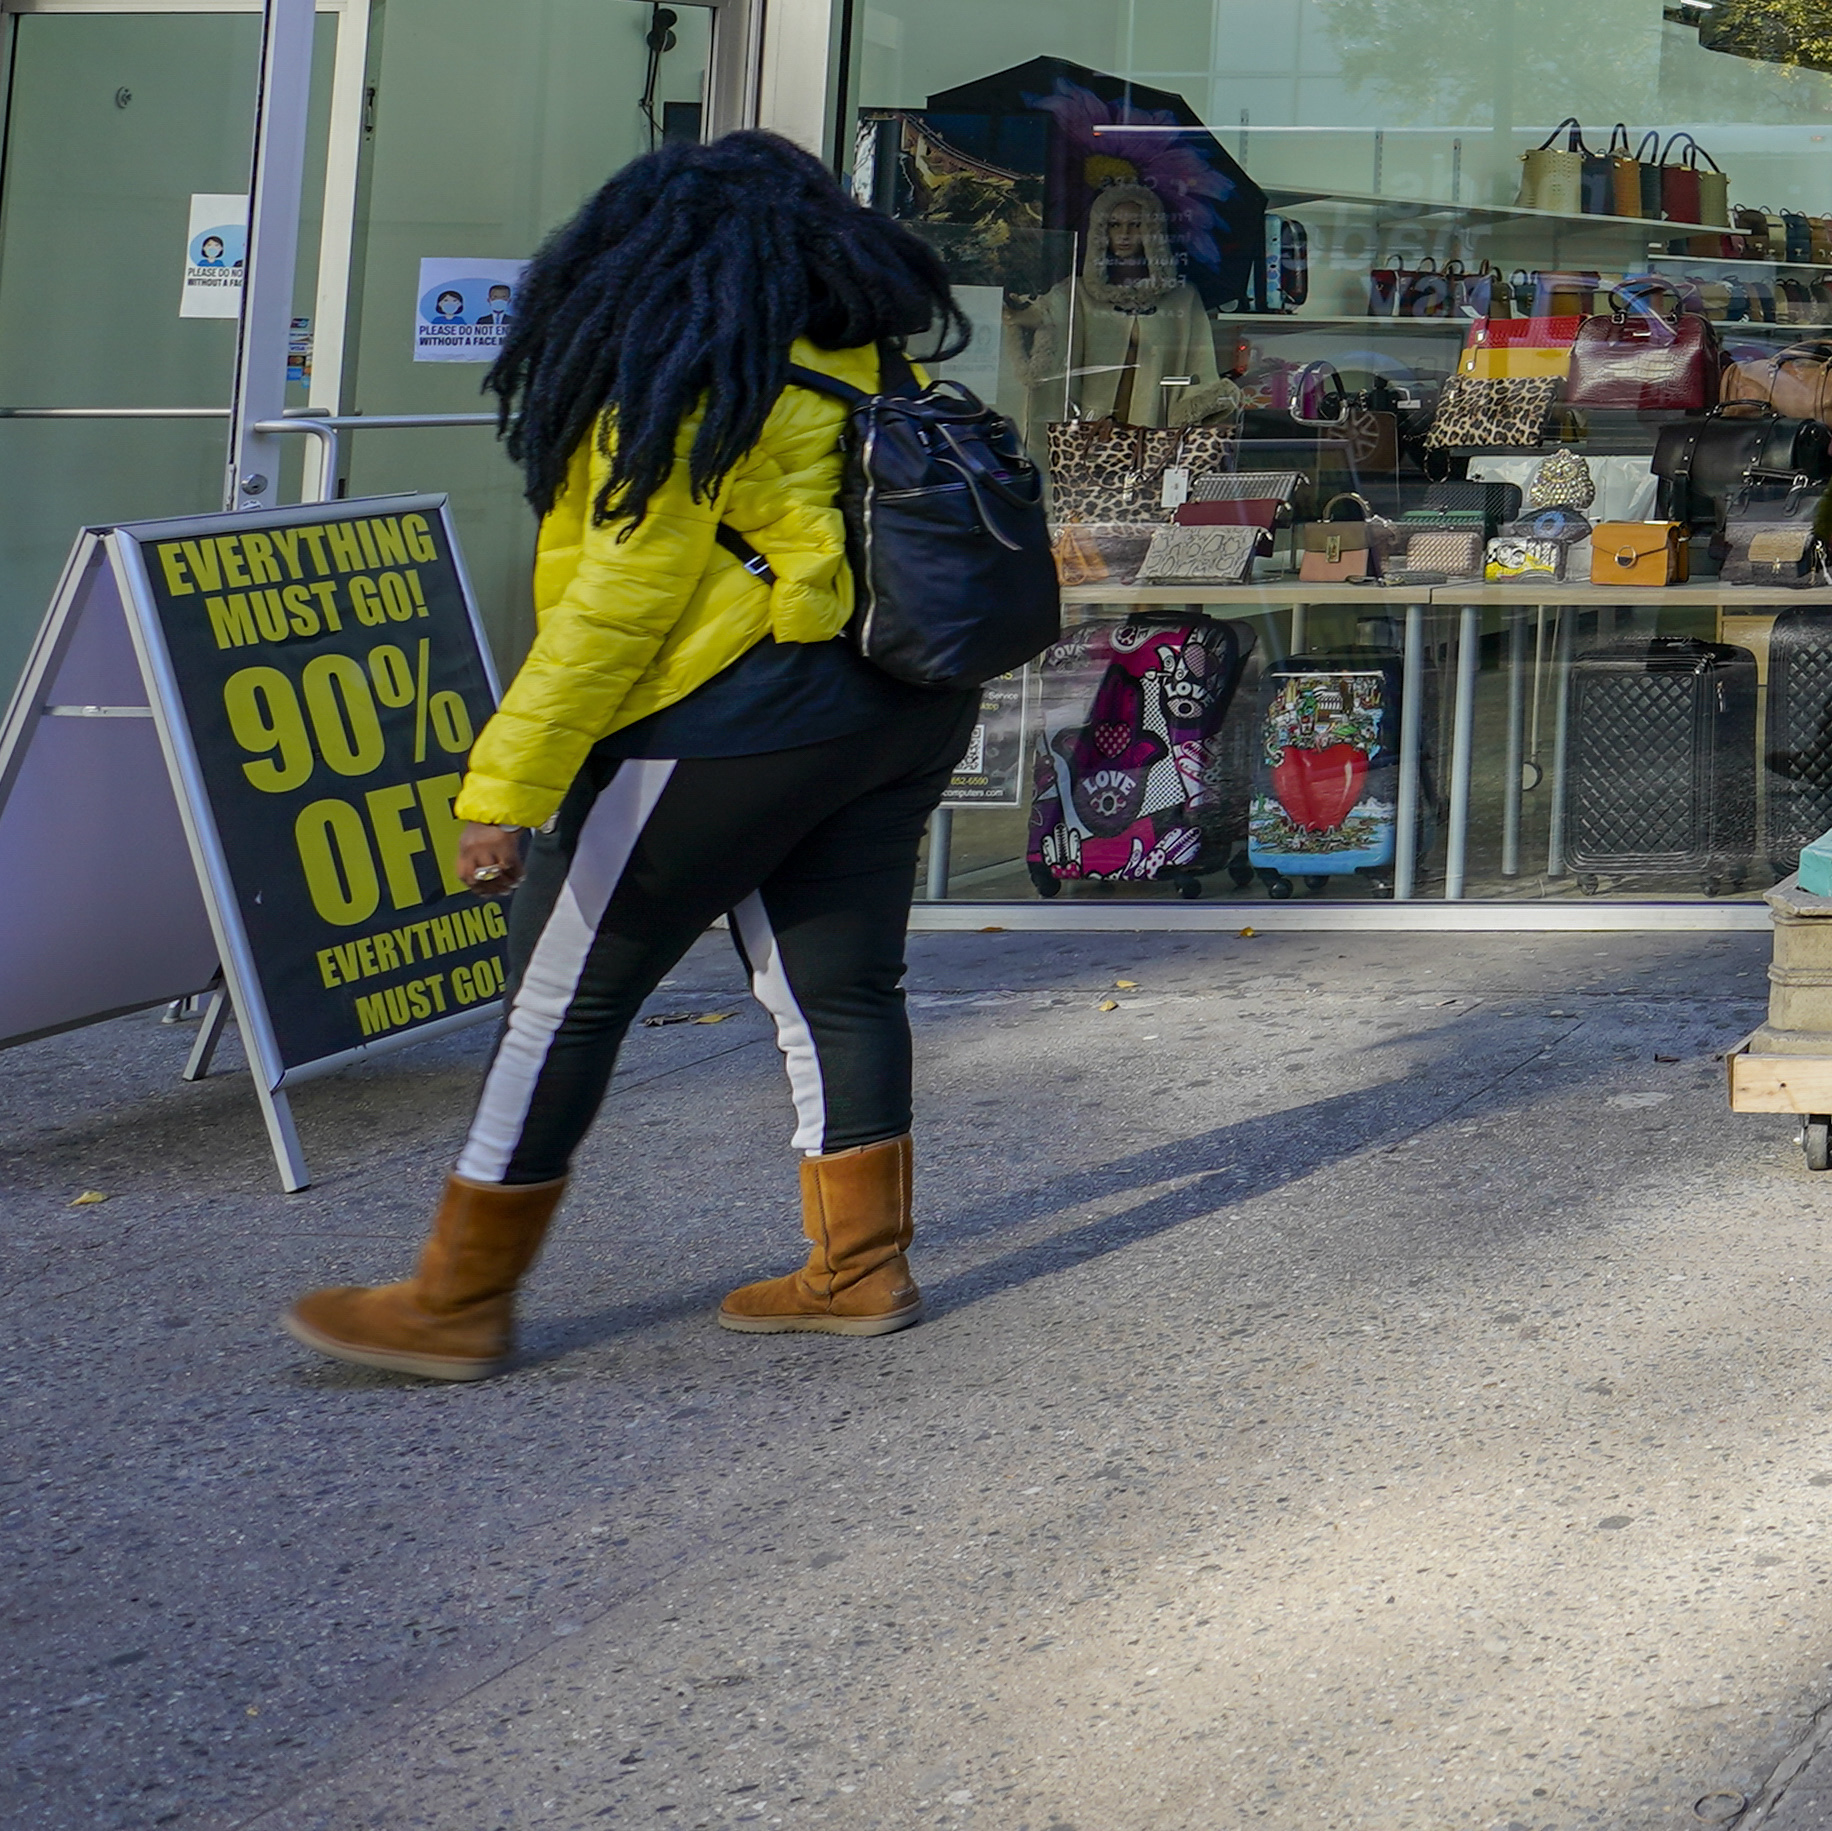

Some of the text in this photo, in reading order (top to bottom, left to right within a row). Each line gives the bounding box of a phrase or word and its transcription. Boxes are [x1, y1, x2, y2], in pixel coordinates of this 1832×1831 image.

[188, 268, 230, 278] PLEASE DO
[188, 278, 222, 287] WITHOUT
[419, 336, 495, 346] WITHOUT A FACE
[420, 325, 456, 336] PLEASE
[458, 325, 473, 336] DO
[474, 325, 493, 336] NOT
[157, 513, 436, 597] EVERYTHING
[205, 570, 431, 651] MUST GO!
[988, 691, 1019, 700] Service
[223, 638, 474, 794] 90%
[1081, 769, 1137, 796] LOVE
[316, 902, 505, 989] EVERYTHING
[355, 956, 505, 1037] MUST GO!
